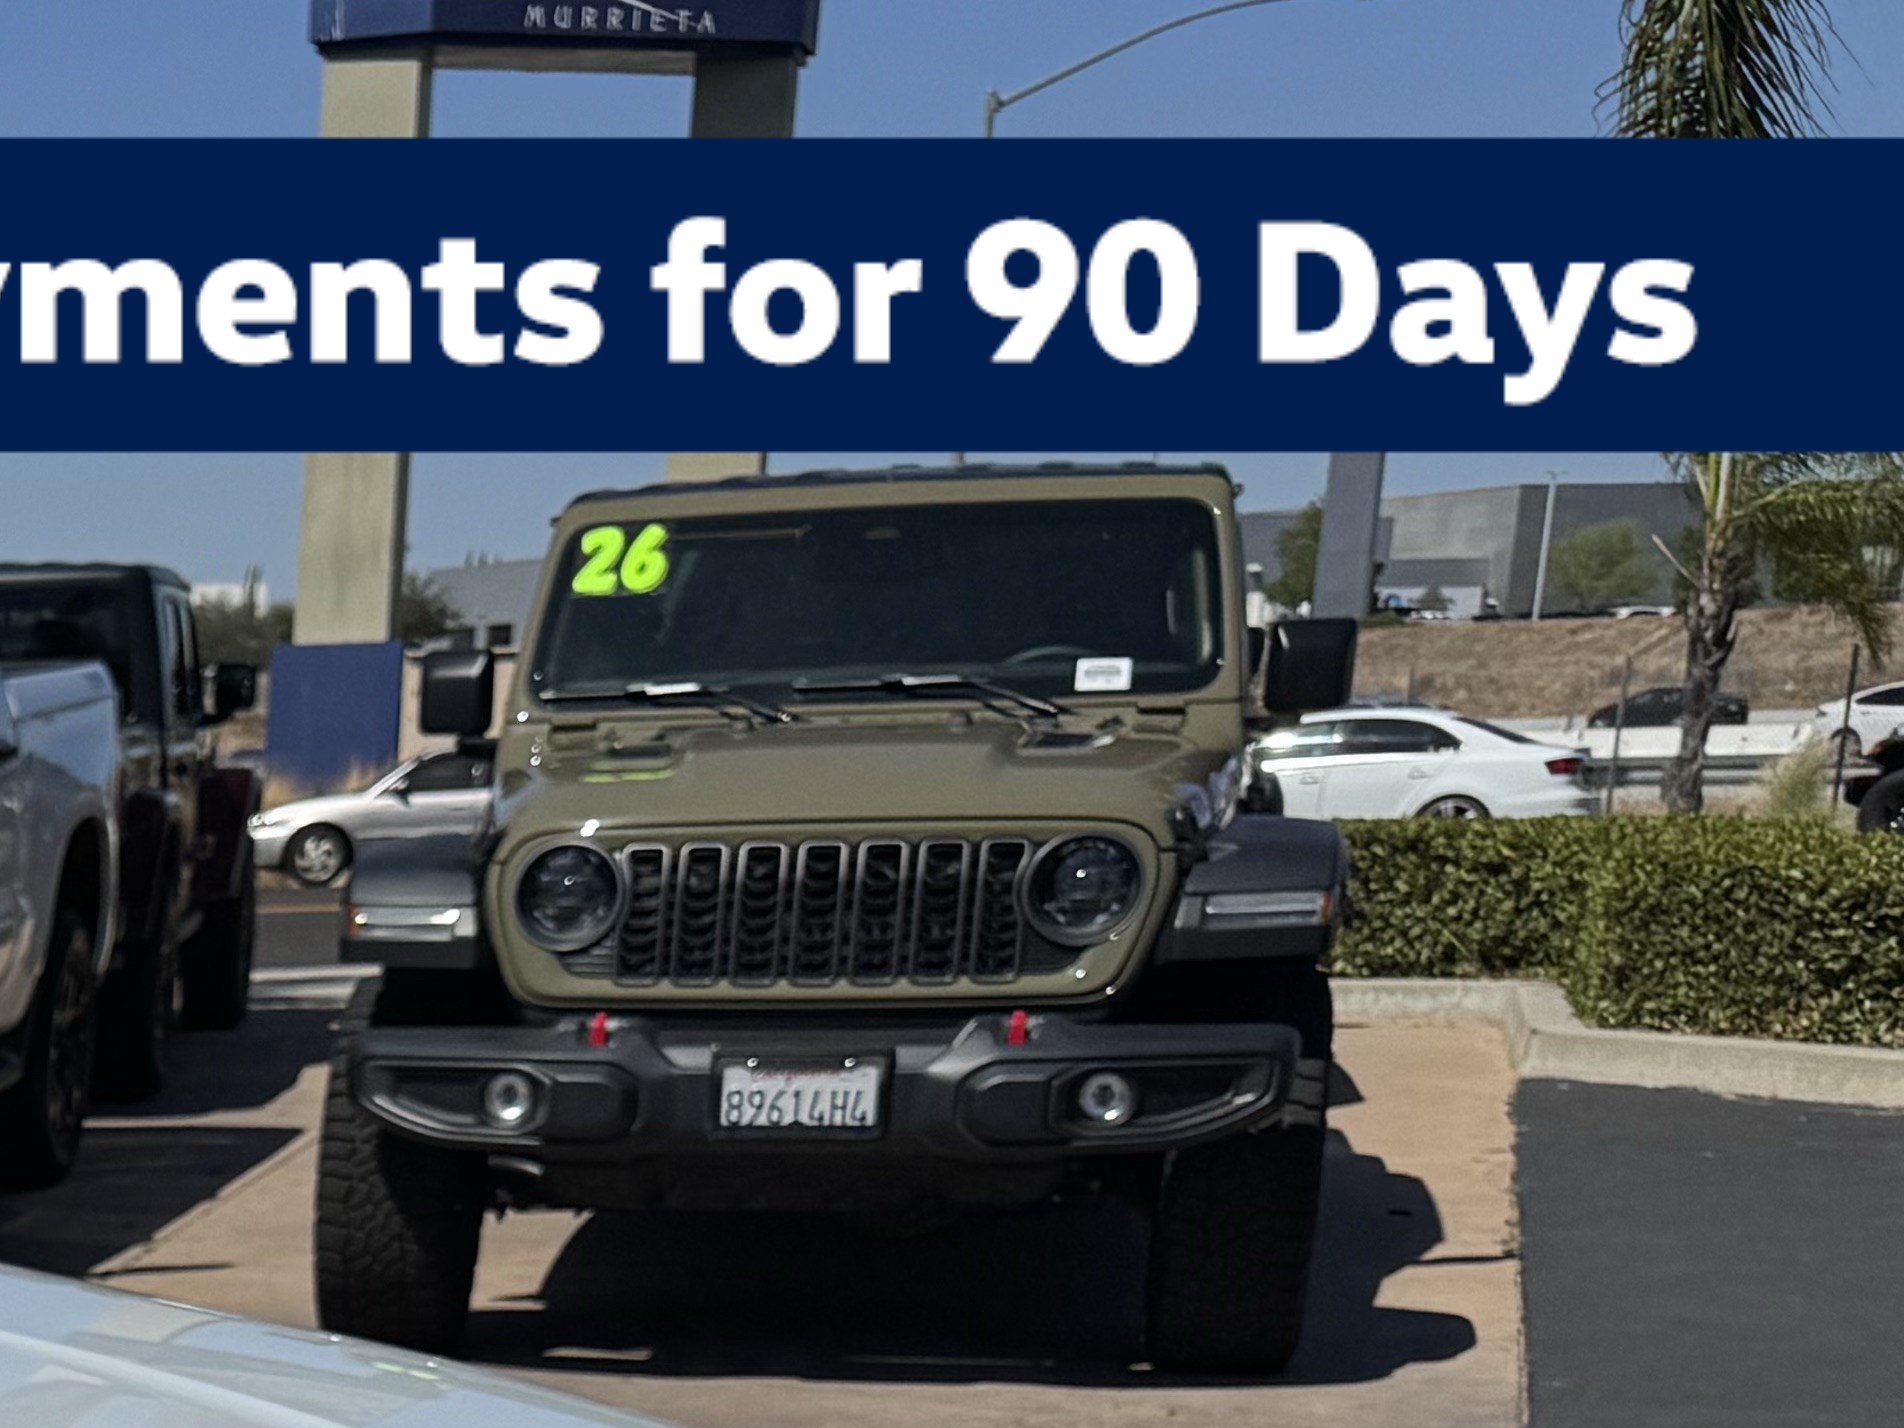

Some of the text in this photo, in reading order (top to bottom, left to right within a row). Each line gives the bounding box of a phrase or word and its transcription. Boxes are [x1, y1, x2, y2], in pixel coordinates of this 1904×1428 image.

[523, 4, 717, 34] MURRIETA
[572, 522, 669, 596] 26
[725, 1088, 866, 1126] 89614H4
